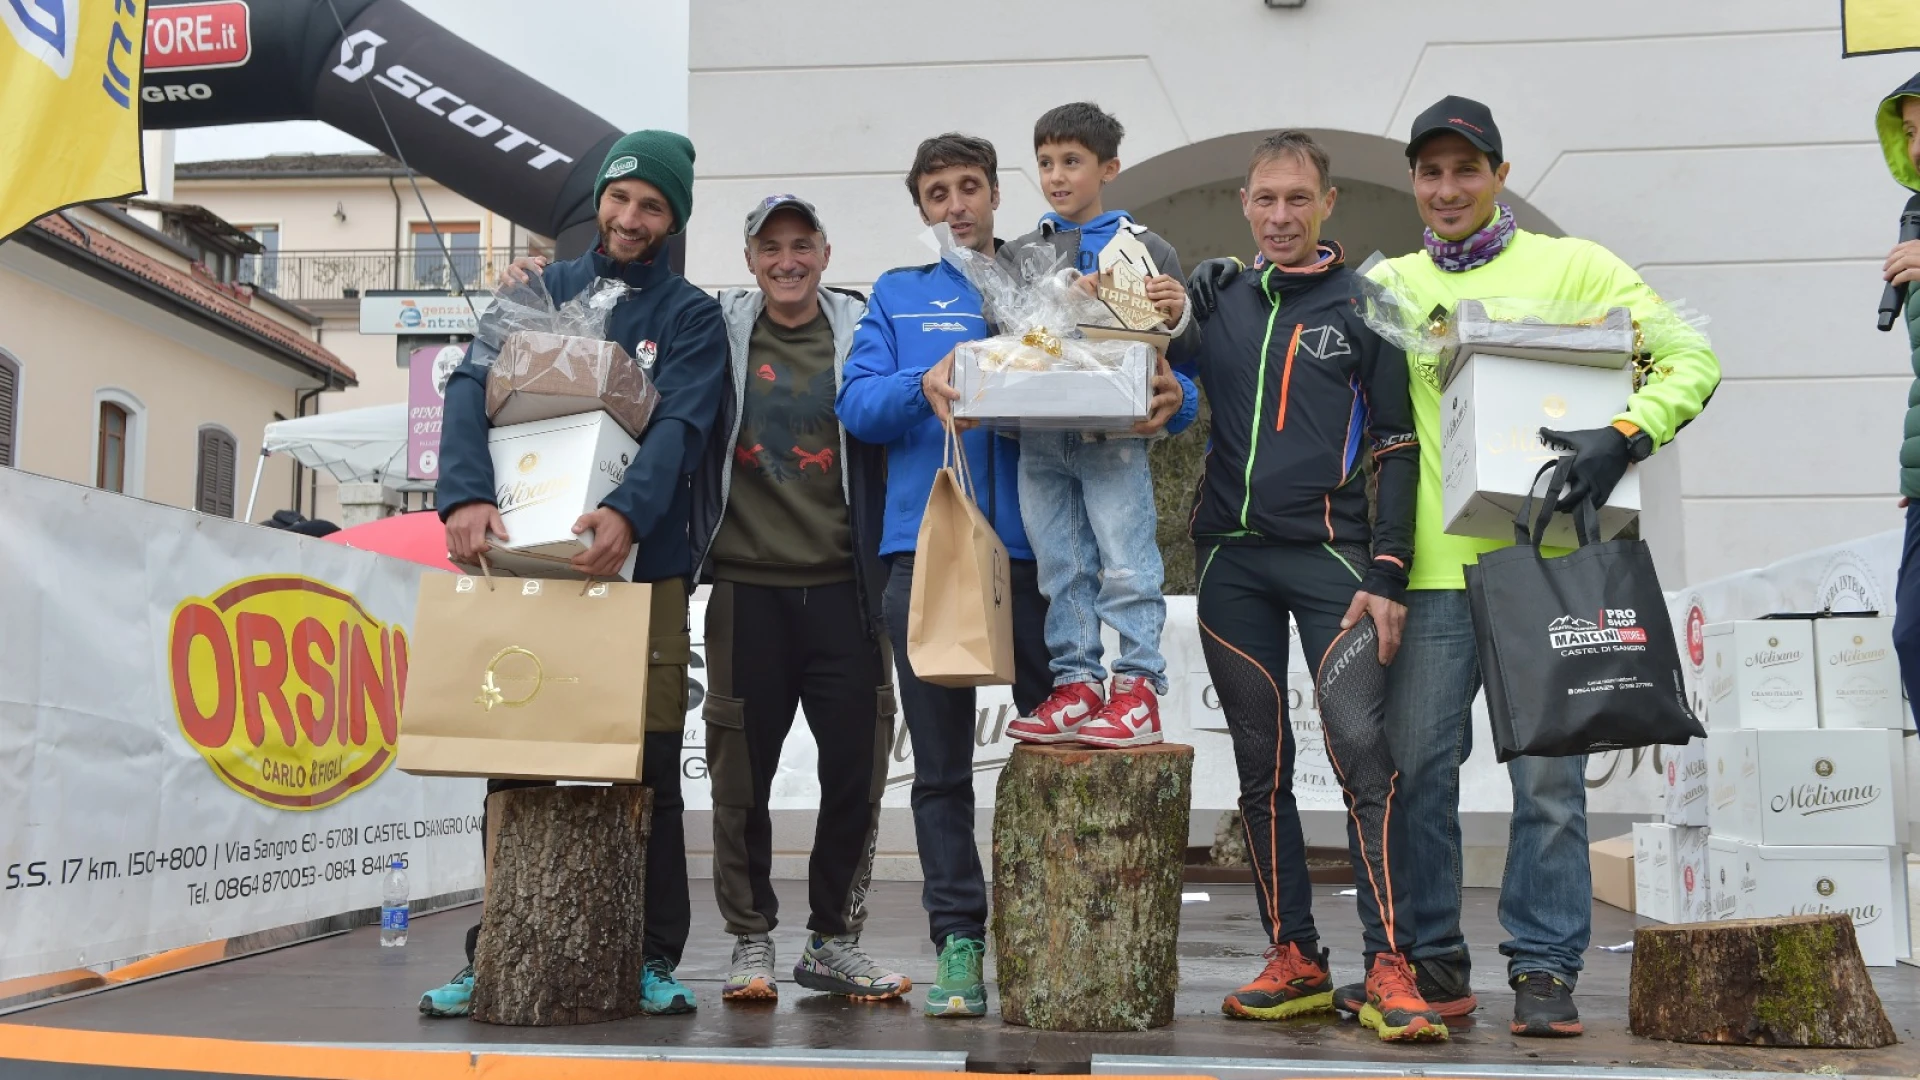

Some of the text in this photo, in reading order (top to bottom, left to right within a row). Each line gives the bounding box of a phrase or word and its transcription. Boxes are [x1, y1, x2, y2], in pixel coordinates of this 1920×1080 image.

[142, 83, 212, 102] GRO
[373, 65, 574, 170] SCOTT
[1100, 287, 1130, 303] TAP
[1605, 608, 1637, 619] PRO
[1607, 618, 1637, 627] SHOP
[1554, 629, 1620, 647] MANCINI
[1326, 626, 1375, 685] CRAZY
[1560, 647, 1600, 658] CASTEL
[262, 757, 307, 788] CARLO
[1771, 783, 1881, 816] Molisana
[6, 861, 52, 890] S.S.
[61, 858, 84, 884] 17
[88, 857, 121, 881] km.
[127, 846, 207, 877] 150+800
[226, 841, 250, 863] Via
[254, 838, 298, 861] Sangro
[364, 822, 411, 844] CASTEL
[187, 881, 210, 905] Tel.
[215, 876, 259, 901] 0864
